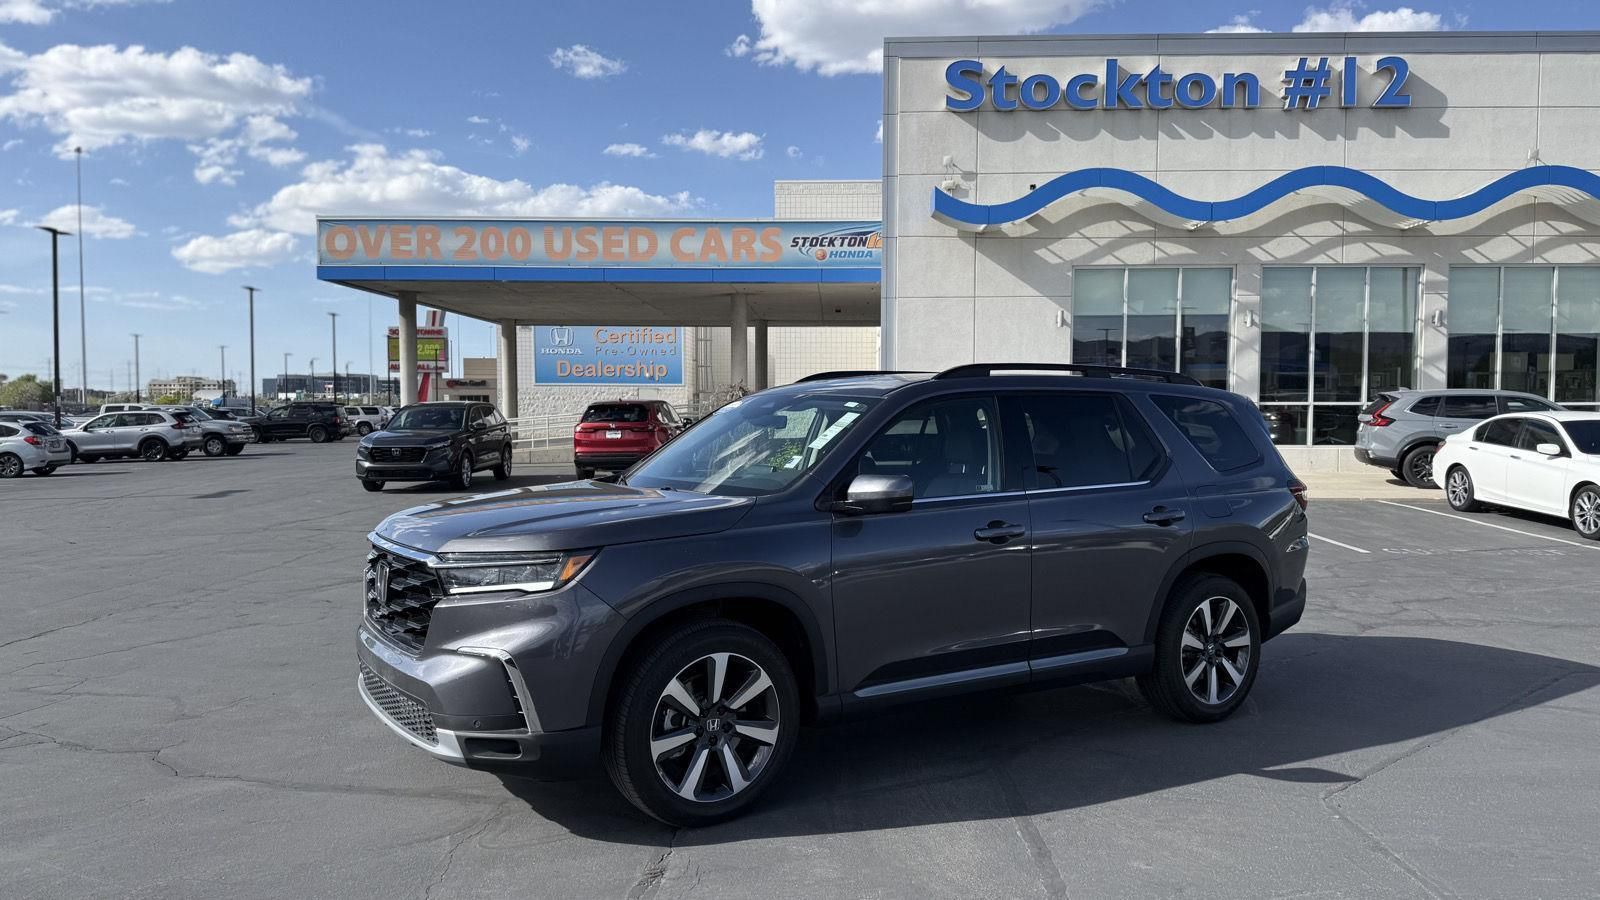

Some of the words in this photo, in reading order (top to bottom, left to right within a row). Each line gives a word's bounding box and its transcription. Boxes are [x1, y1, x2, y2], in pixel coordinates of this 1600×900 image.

[944, 58, 1260, 111] Stockton
[1282, 56, 1413, 112] #12
[325, 224, 443, 260] OVER
[452, 226, 532, 261] 200
[543, 226, 658, 262] USED
[670, 227, 784, 263] CARS
[790, 236, 868, 248] STOCKTON
[829, 250, 873, 259] HONDA
[594, 327, 677, 344] Certified
[541, 347, 583, 355] HONDA
[595, 345, 677, 356] Pre-Owned
[556, 359, 668, 381] Dealership
